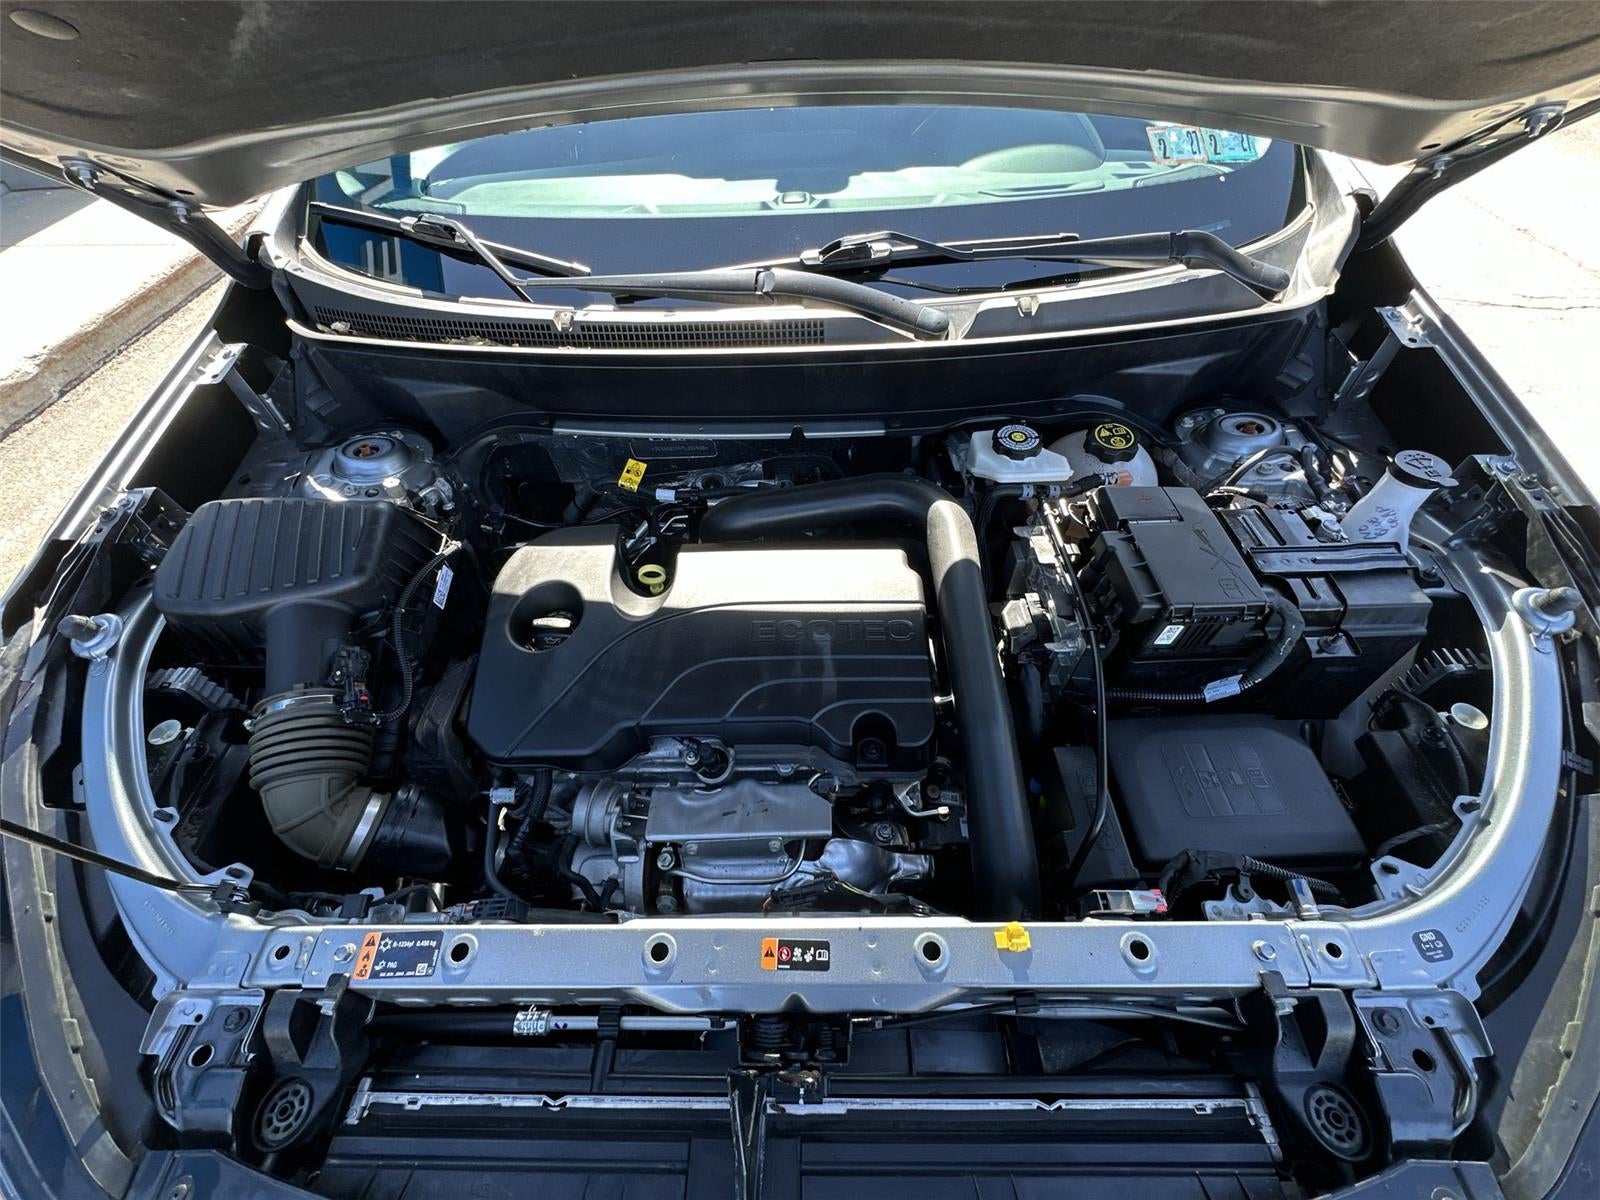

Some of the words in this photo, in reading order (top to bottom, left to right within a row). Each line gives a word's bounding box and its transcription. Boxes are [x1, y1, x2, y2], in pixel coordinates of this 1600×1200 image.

[1158, 138, 1170, 159] 2
[1186, 130, 1201, 155] 27
[1209, 134, 1221, 155] 2
[750, 618, 914, 642] ECOTEC
[1419, 931, 1436, 941] GND
[386, 961, 398, 969] PAG
